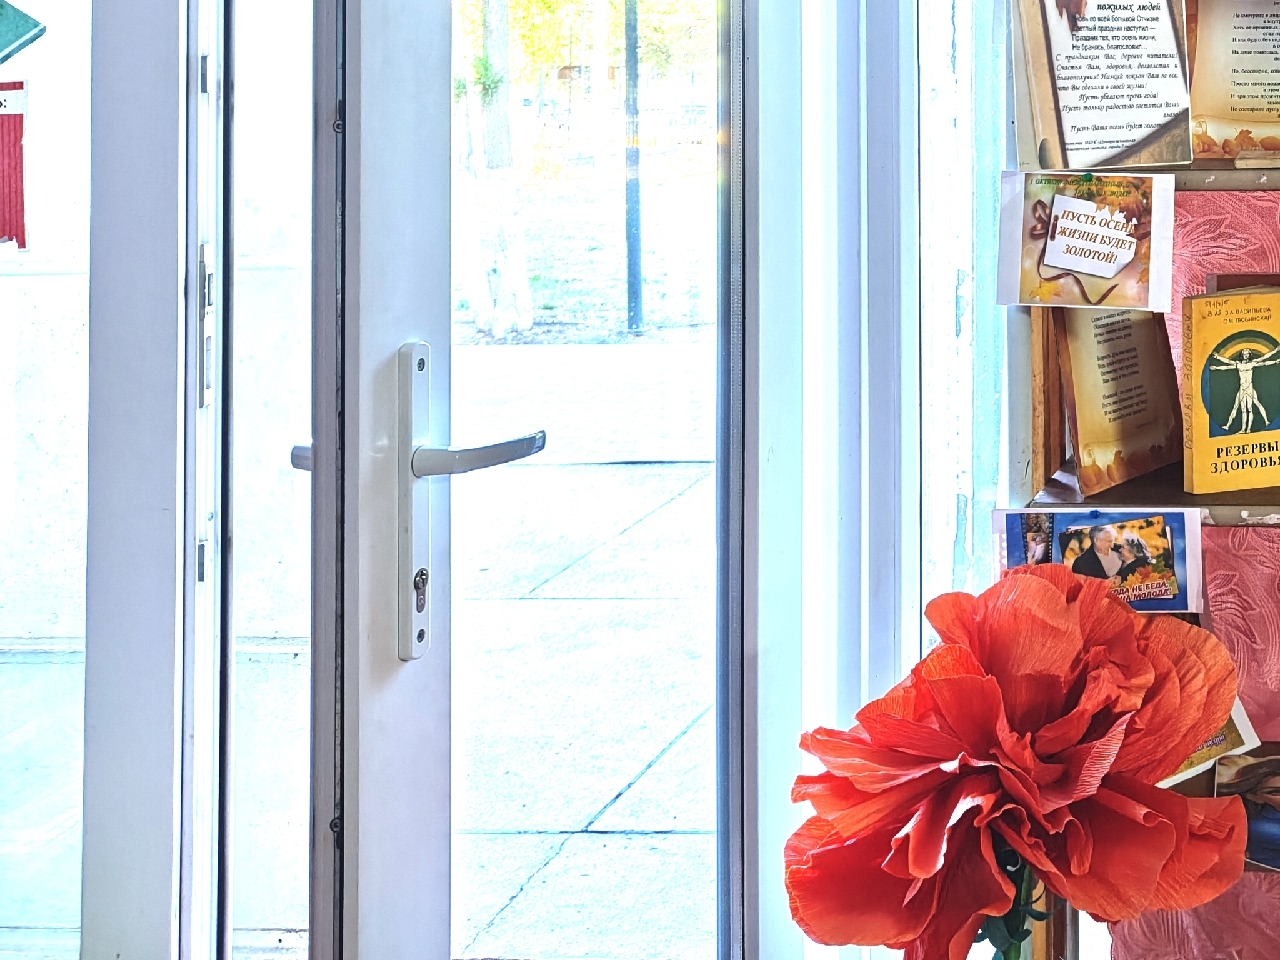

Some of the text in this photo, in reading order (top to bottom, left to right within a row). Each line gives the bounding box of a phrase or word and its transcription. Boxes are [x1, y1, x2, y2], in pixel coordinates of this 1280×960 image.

[1097, 1, 1161, 13] пожилых людей
[1061, 210, 1135, 234] ПУСТЬ ОСЕНЬ
[1057, 226, 1135, 251] ЖИЗНИ БУДЕТ
[1062, 244, 1118, 264] ЗОЛОТОЙ!
[1215, 440, 1280, 459] РЕЗЕРВЫ
[1131, 584, 1143, 594] НЕ
